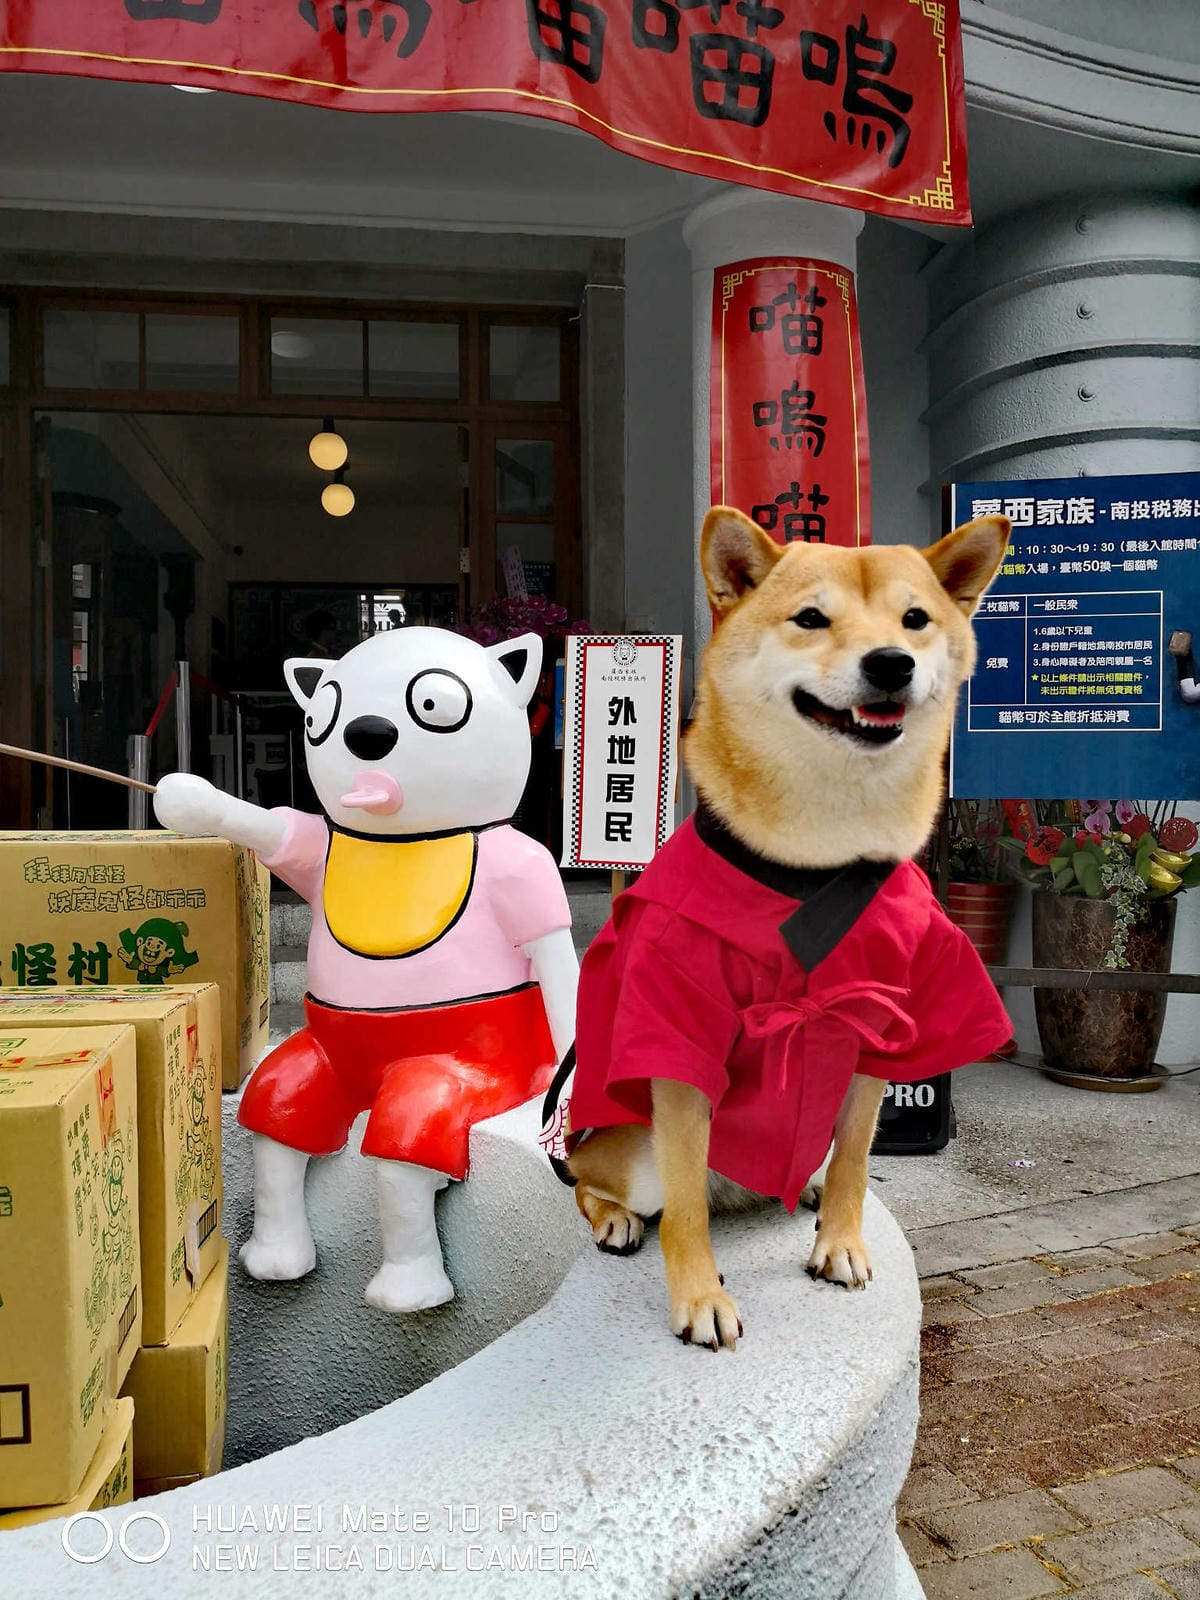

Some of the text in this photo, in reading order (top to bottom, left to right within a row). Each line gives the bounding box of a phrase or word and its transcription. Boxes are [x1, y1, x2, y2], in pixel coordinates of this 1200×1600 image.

[986, 657, 1008, 669] 免費
[999, 710, 1130, 723] 貓幣可於全館折抵消費
[604, 696, 637, 842] 外地居民
[0, 941, 112, 985] 怪村
